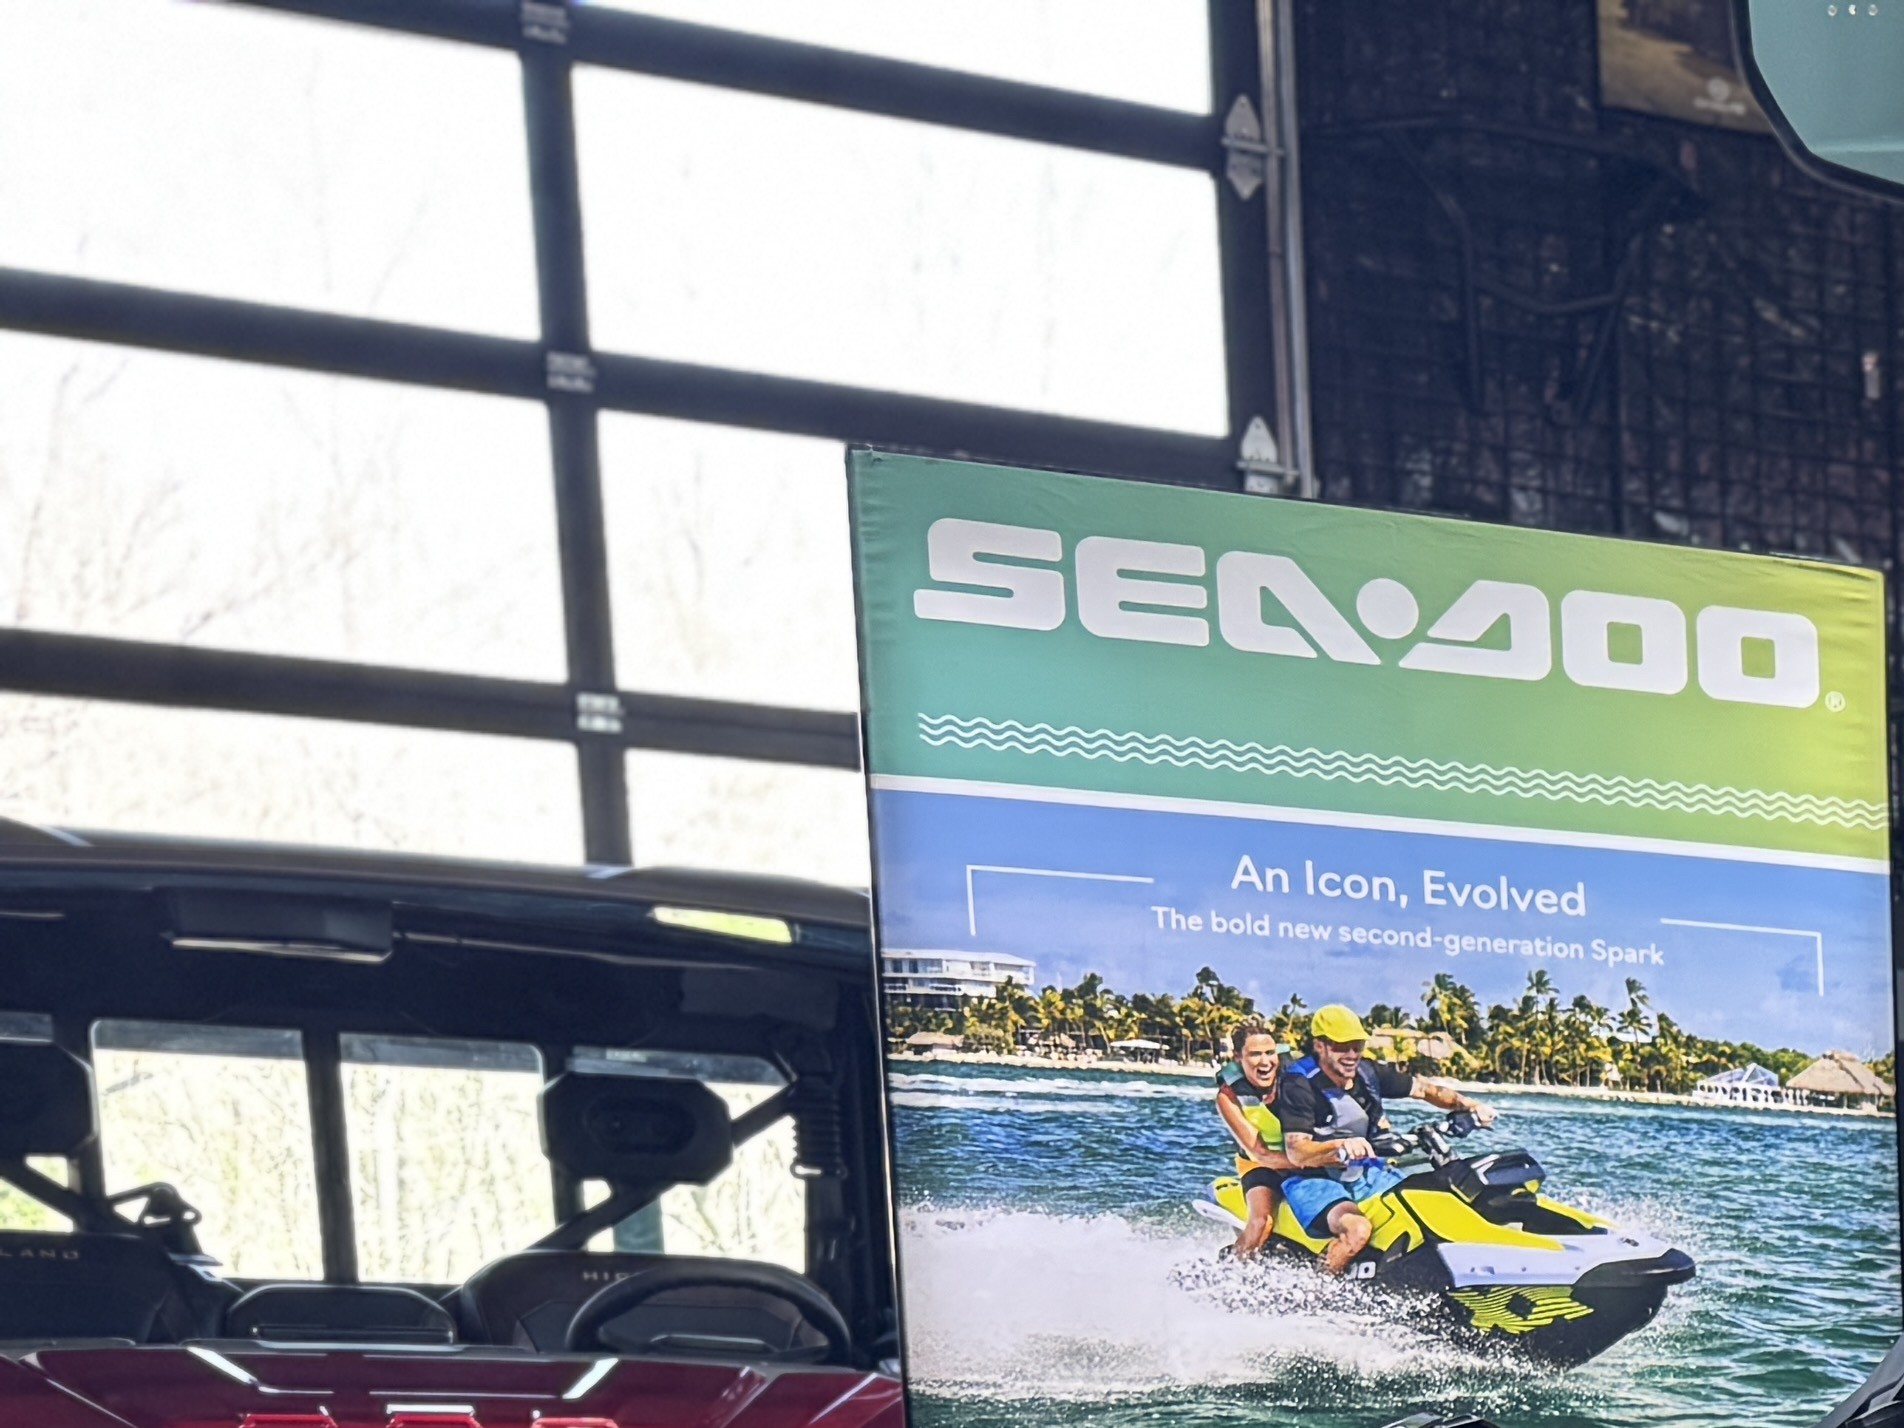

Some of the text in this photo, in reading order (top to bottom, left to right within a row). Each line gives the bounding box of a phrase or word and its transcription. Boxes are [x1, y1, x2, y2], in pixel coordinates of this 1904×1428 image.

[1231, 854, 1586, 917] An Icon, Evolved
[1151, 906, 1664, 968] The bold new second-generation Spark
